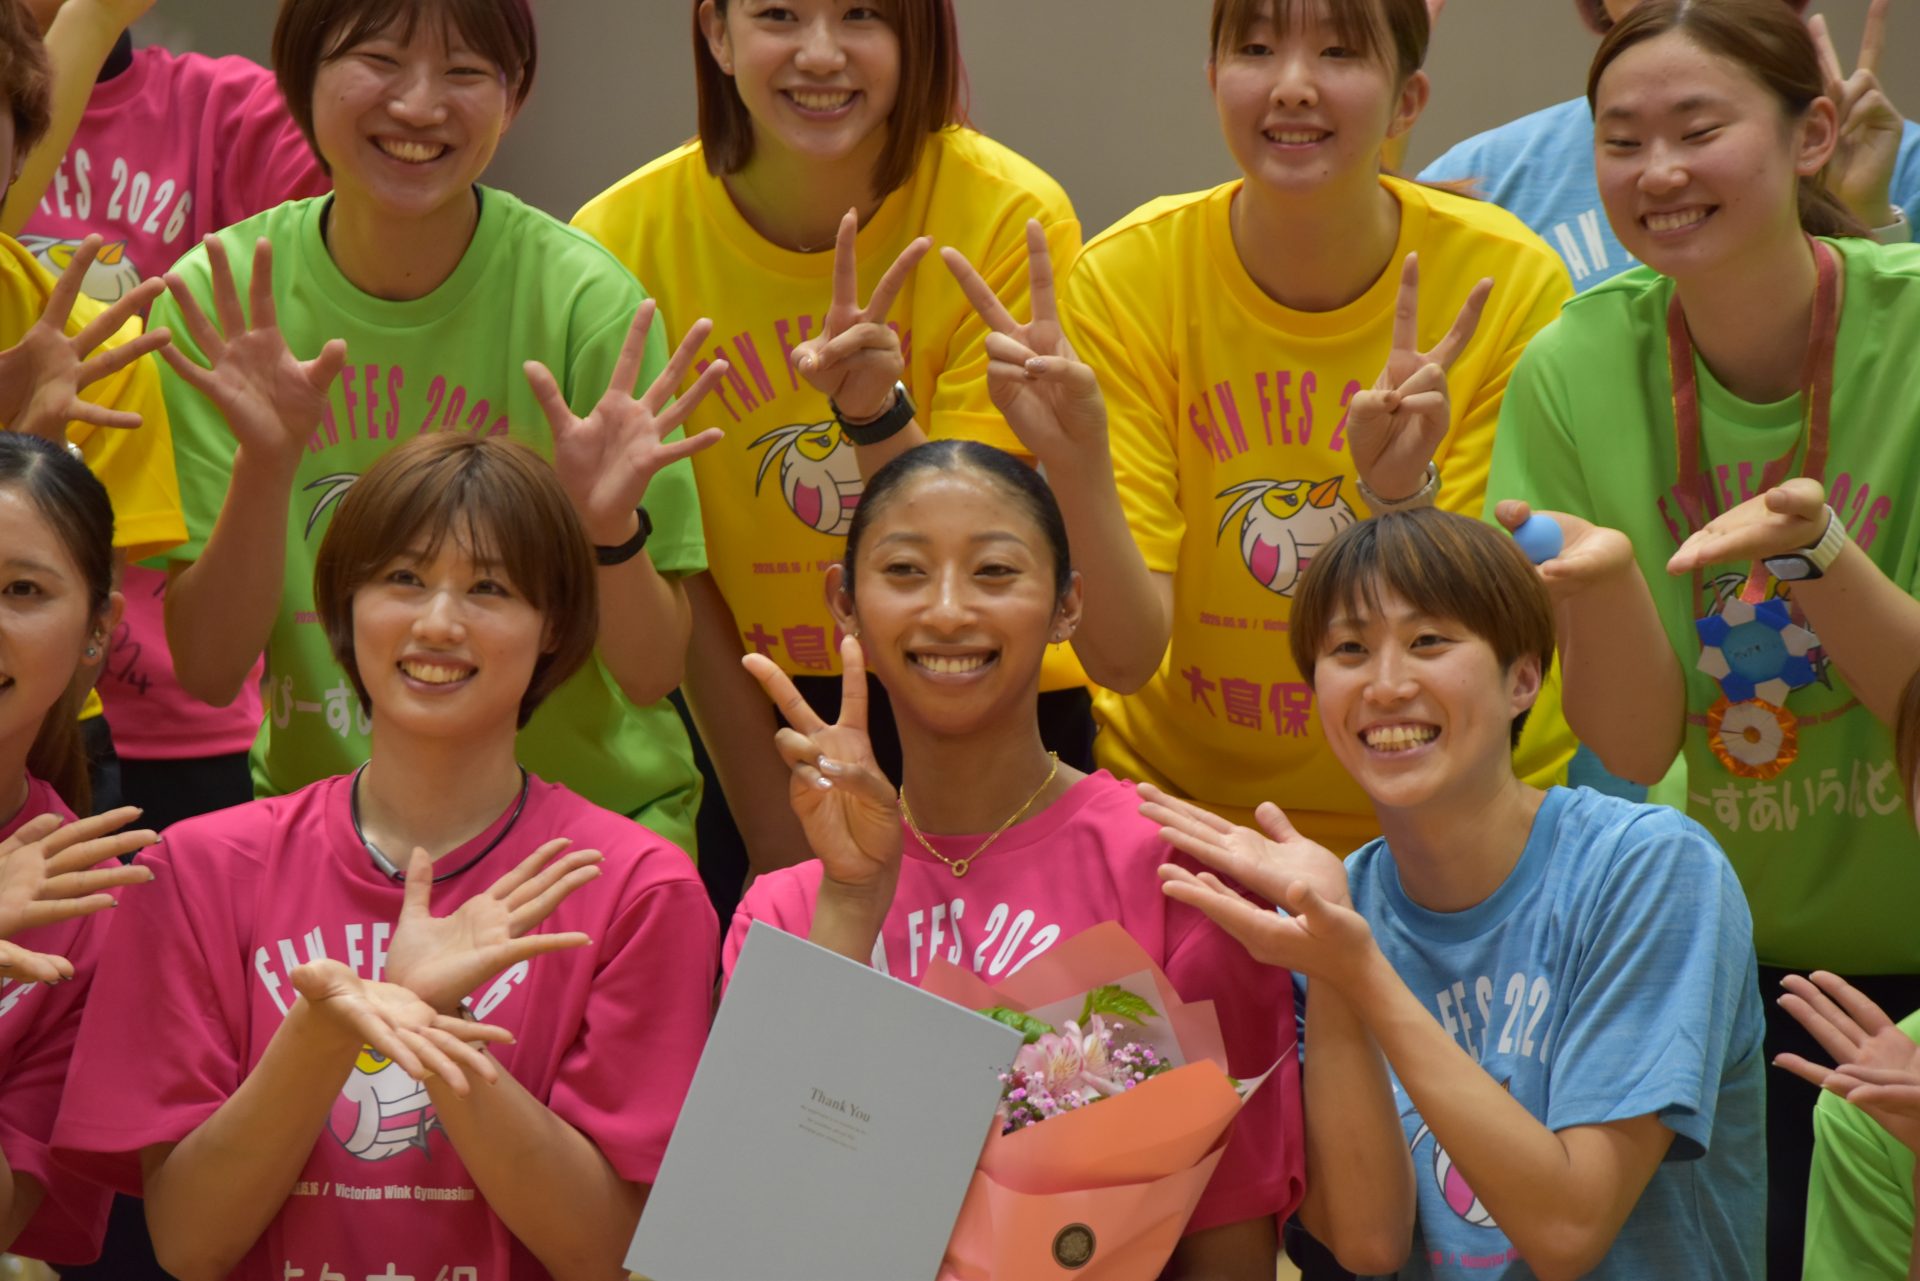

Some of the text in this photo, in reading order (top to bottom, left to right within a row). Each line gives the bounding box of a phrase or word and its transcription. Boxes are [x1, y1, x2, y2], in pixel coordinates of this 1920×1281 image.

[42, 148, 192, 244] ES 2026
[1553, 209, 1610, 280] AN
[341, 364, 404, 440] FES
[1255, 371, 1317, 446] FES
[1829, 472, 1892, 550] 026
[1181, 665, 1313, 738] 大島保
[908, 898, 965, 977] FES
[973, 903, 1061, 978] 202
[811, 1087, 846, 1112] Thank
[850, 1103, 871, 1122] You
[335, 1183, 382, 1200] Victorina
[384, 1185, 411, 1200] Wink
